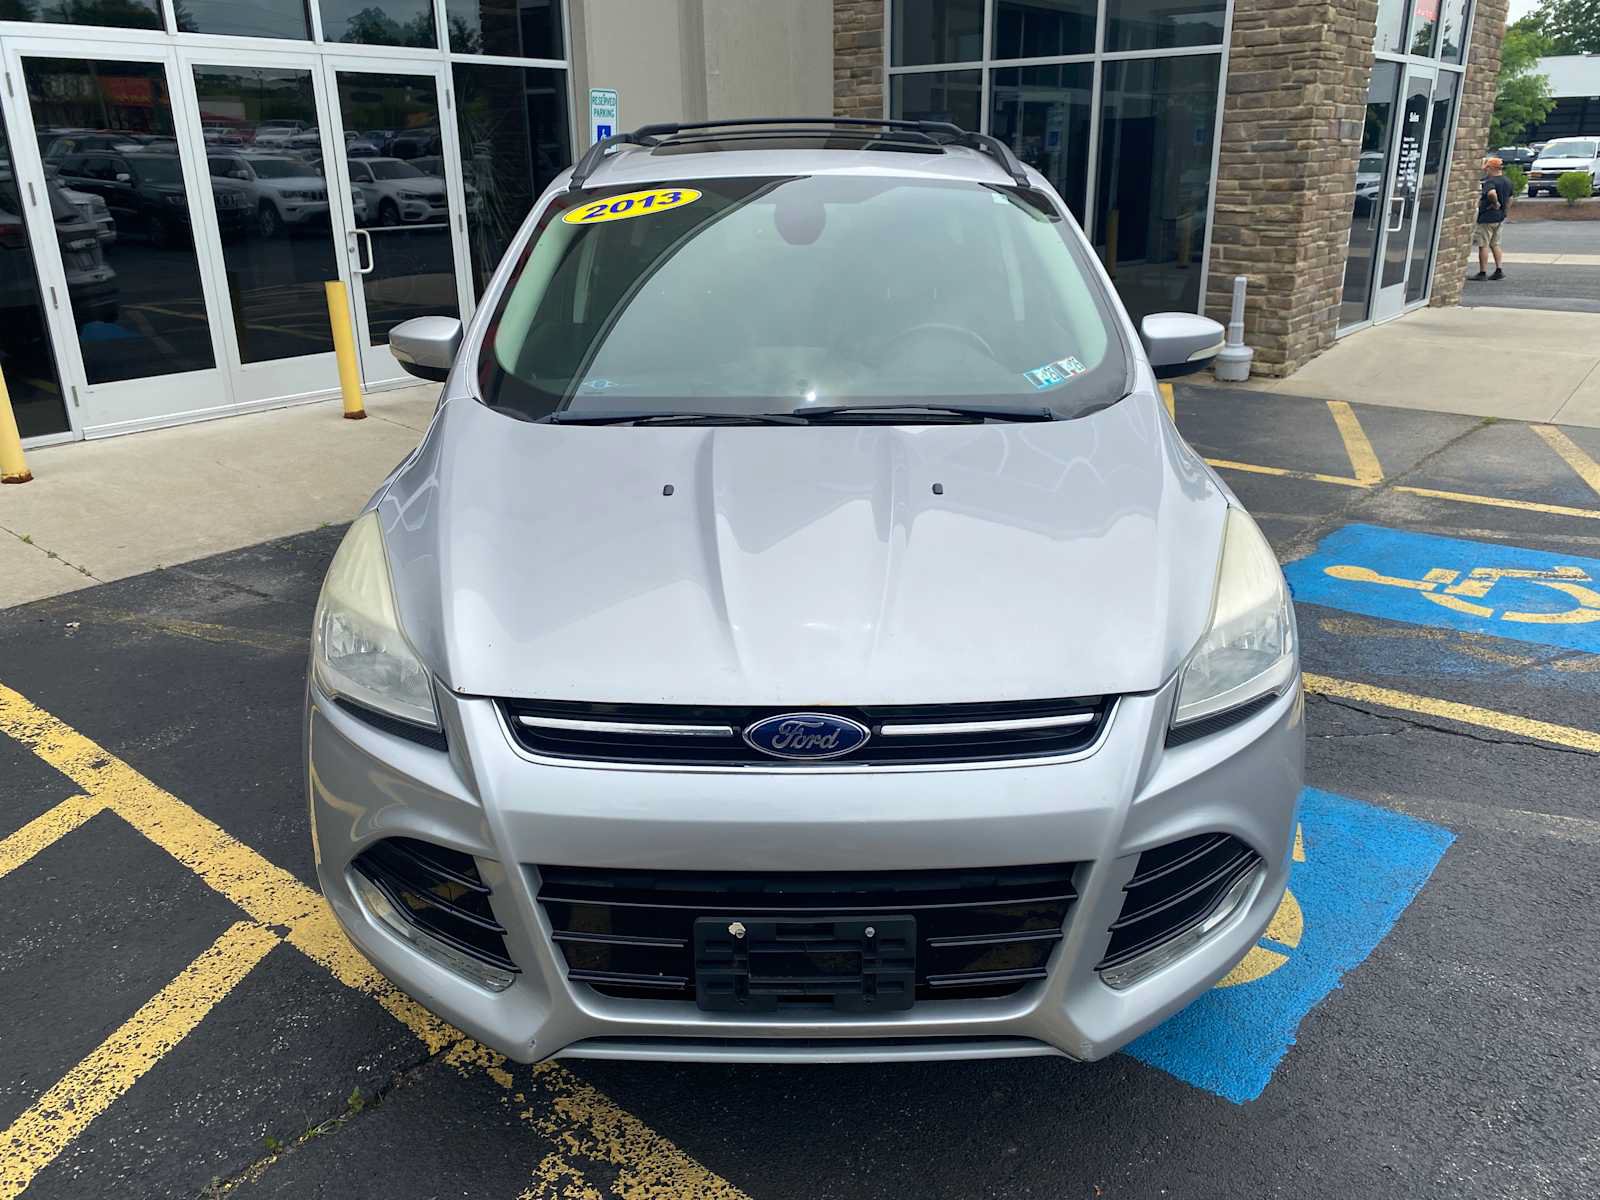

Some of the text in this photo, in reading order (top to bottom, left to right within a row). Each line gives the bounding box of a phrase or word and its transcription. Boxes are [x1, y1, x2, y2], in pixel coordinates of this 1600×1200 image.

[592, 96, 616, 107] RESERVED
[594, 108, 615, 118] PARKING
[582, 191, 682, 221] 2013
[771, 720, 841, 749] Ford
